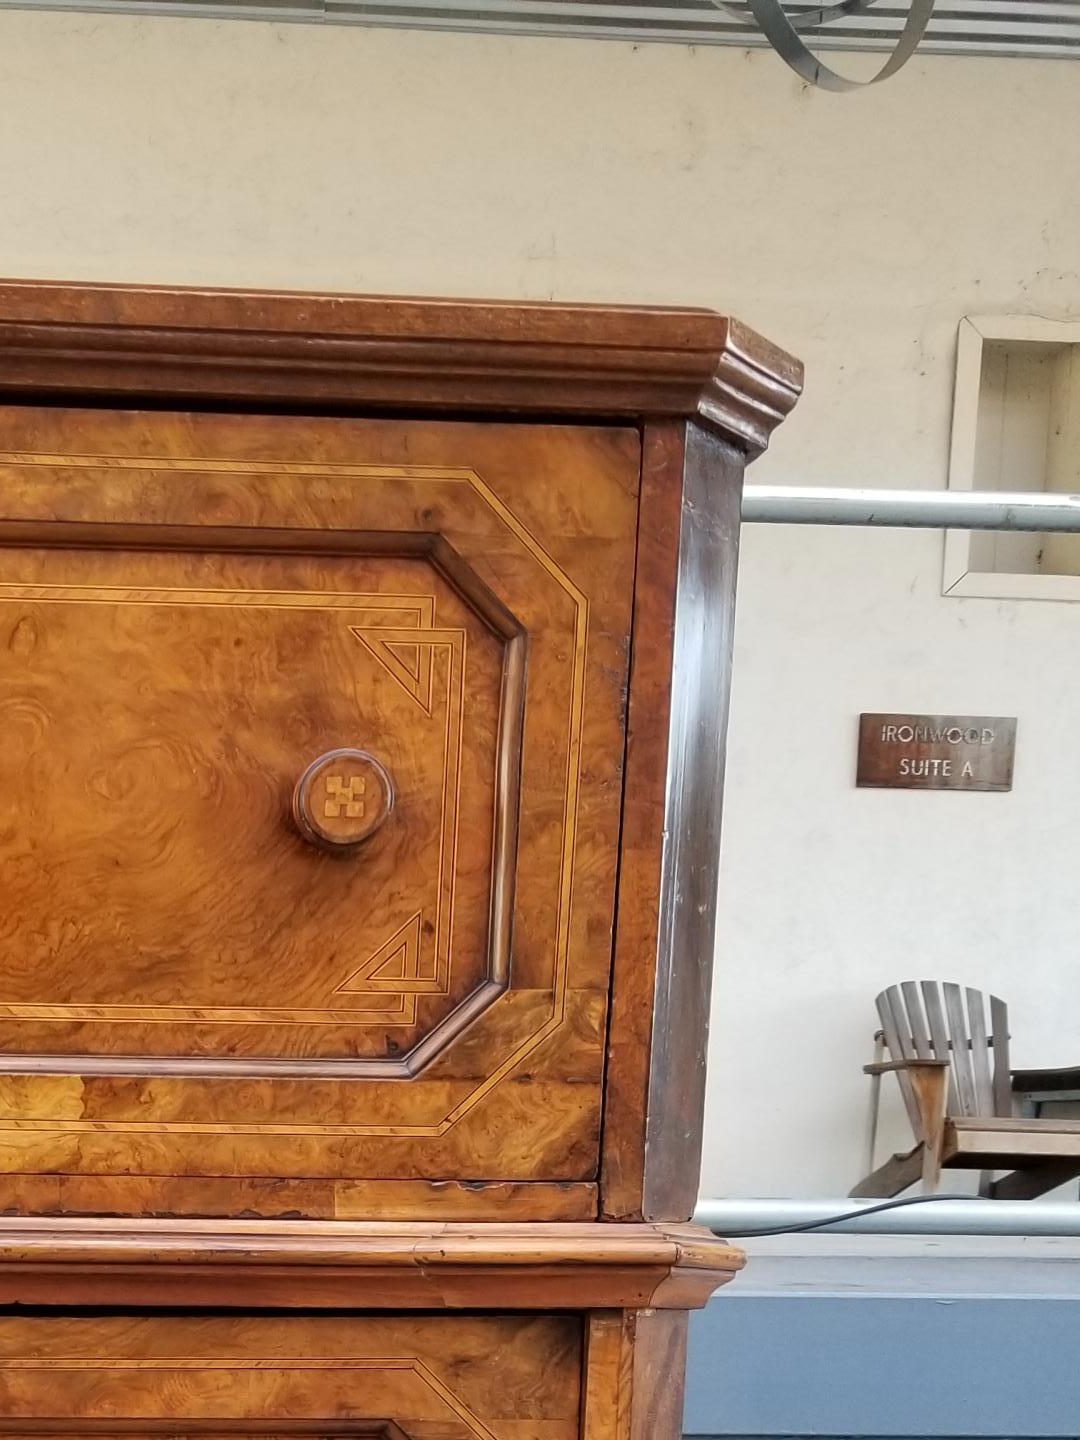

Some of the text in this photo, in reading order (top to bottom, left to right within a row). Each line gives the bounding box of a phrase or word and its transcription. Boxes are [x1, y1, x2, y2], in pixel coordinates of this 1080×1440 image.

[881, 725, 995, 745] IRONWOOD
[899, 758, 974, 777] SUITE A
